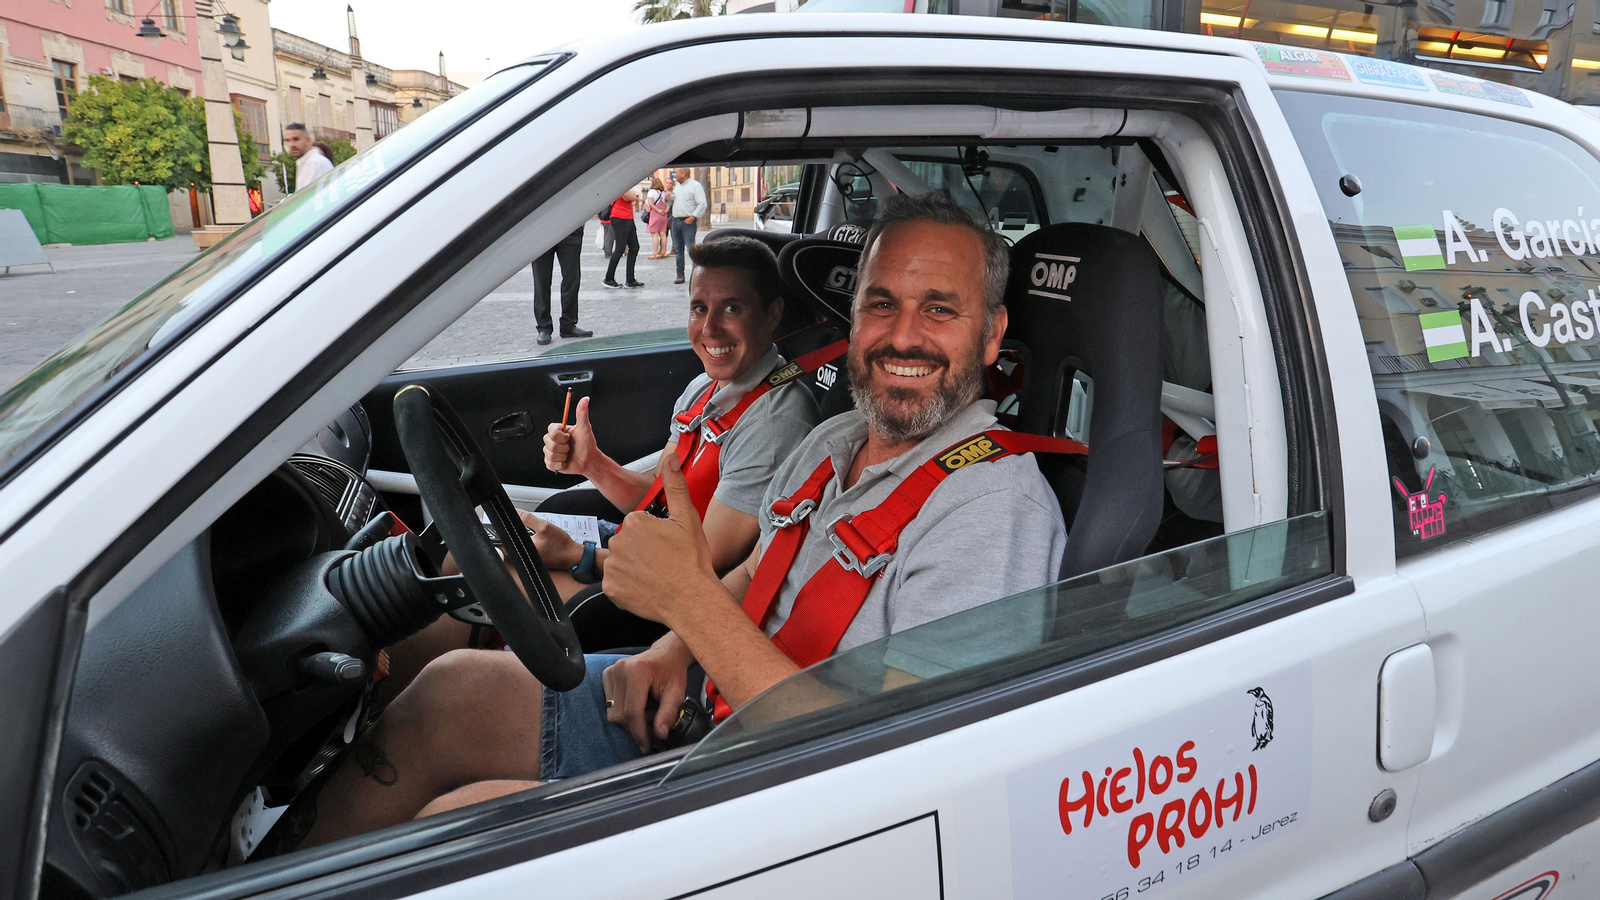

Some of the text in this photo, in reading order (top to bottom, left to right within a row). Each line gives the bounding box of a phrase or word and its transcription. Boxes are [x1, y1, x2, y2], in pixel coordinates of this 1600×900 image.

[1279, 50, 1322, 63] ALGAR
[1354, 61, 1420, 81] GIBRALFARO
[1442, 209, 1489, 265] A.
[828, 265, 858, 293] GT
[1030, 261, 1077, 290] OMP
[1470, 285, 1600, 358] A. Cast
[769, 364, 800, 384] OMP
[816, 366, 837, 388] OMP
[945, 438, 994, 470] OMP
[1127, 763, 1258, 869] PROHI
[1137, 870, 1166, 894] 34
[1175, 853, 1201, 875] 18
[1209, 838, 1233, 859] 14
[1251, 811, 1298, 840] Jerez
